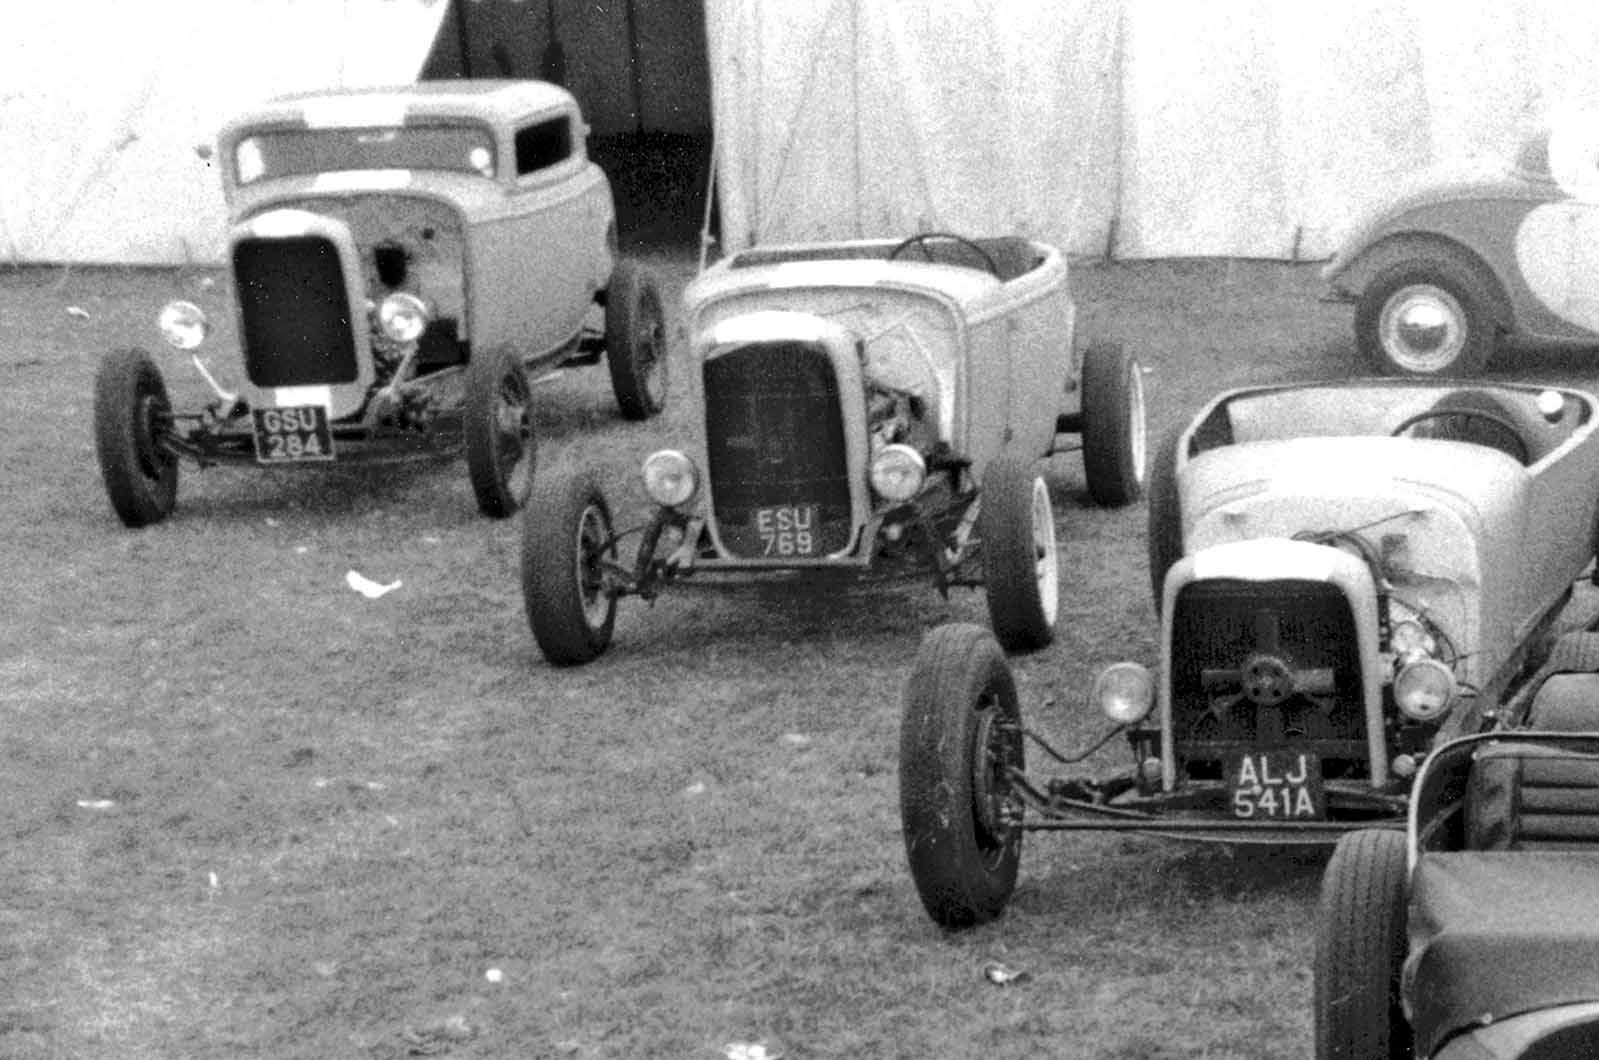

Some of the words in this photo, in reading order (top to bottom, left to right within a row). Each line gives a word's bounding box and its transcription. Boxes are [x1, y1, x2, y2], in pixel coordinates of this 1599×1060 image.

[263, 409, 317, 432] GSU
[268, 433, 321, 456] 284
[758, 507, 811, 532] ESU
[760, 532, 811, 555] 769
[1239, 754, 1307, 785] ALJ
[1234, 787, 1314, 817] 541A
